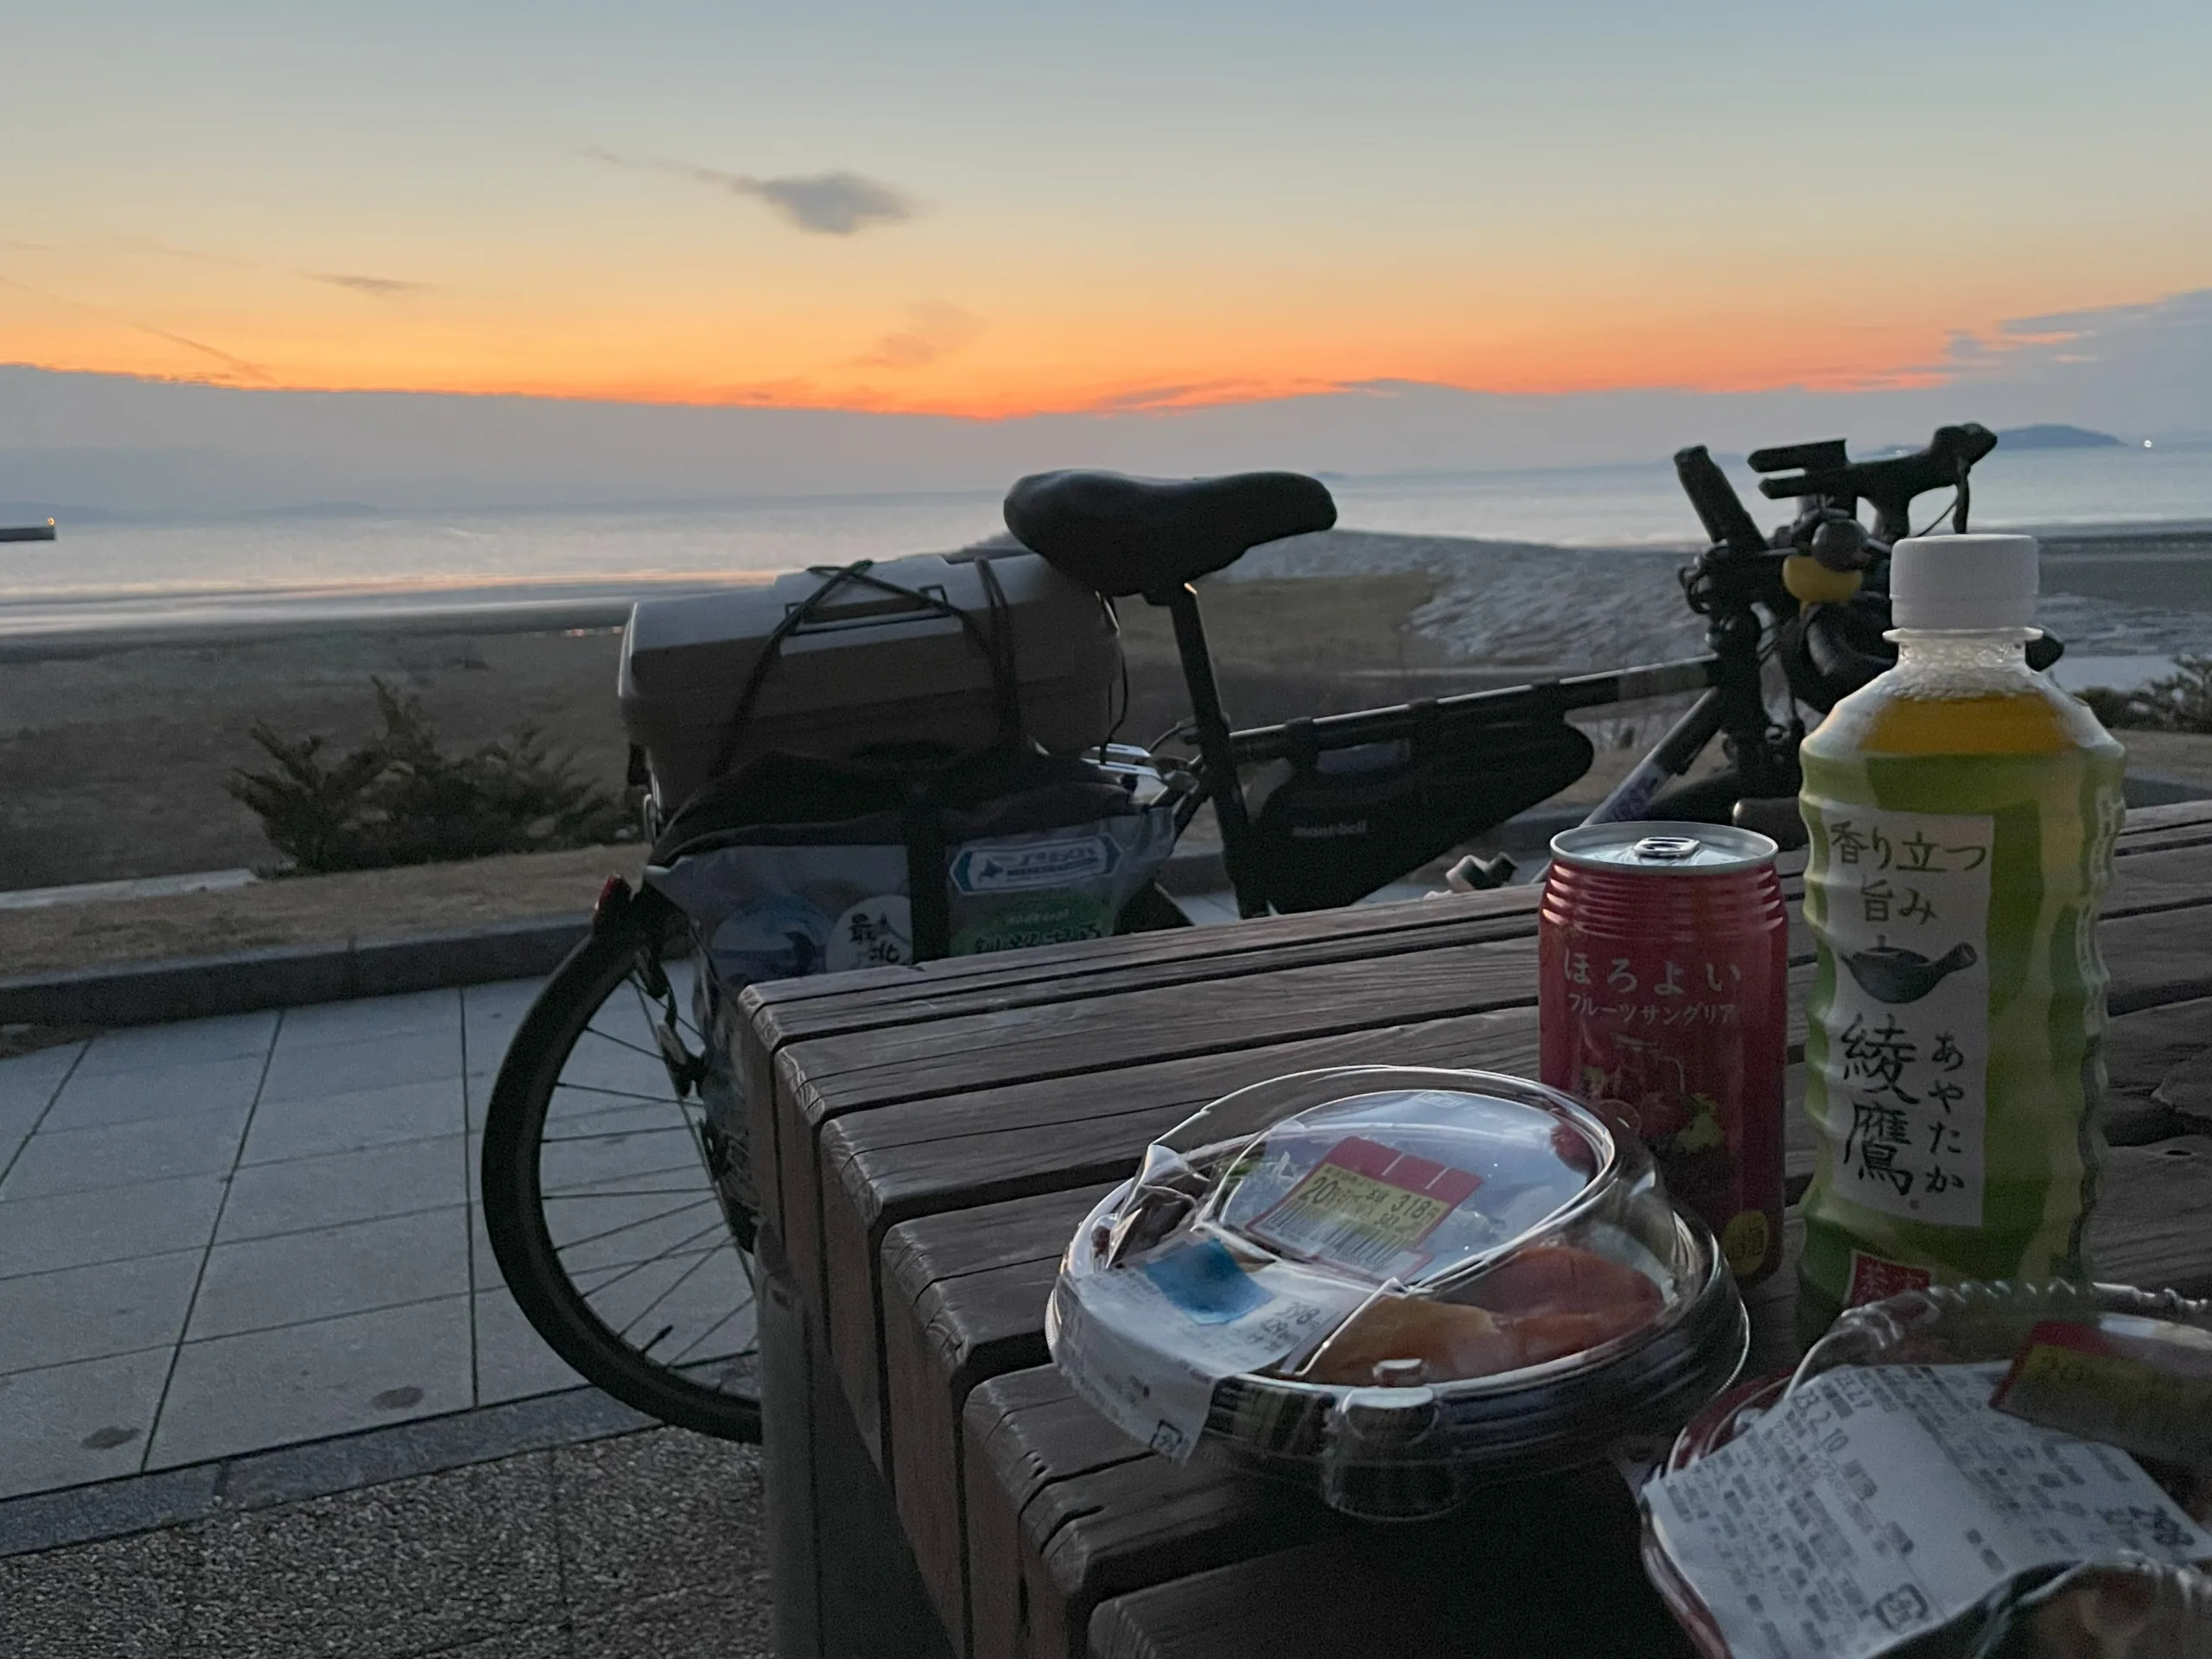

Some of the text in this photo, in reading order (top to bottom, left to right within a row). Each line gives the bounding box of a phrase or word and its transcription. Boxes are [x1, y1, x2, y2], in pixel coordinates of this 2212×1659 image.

[1831, 821, 1986, 872] 香り立つ
[1860, 879, 1938, 925] 旨み
[1563, 951, 1741, 996] ほろよい
[1567, 992, 1736, 1027] フルーツサングリア
[1840, 1013, 1920, 1196] 綾鷹
[1926, 1032, 1965, 1194] あやたか
